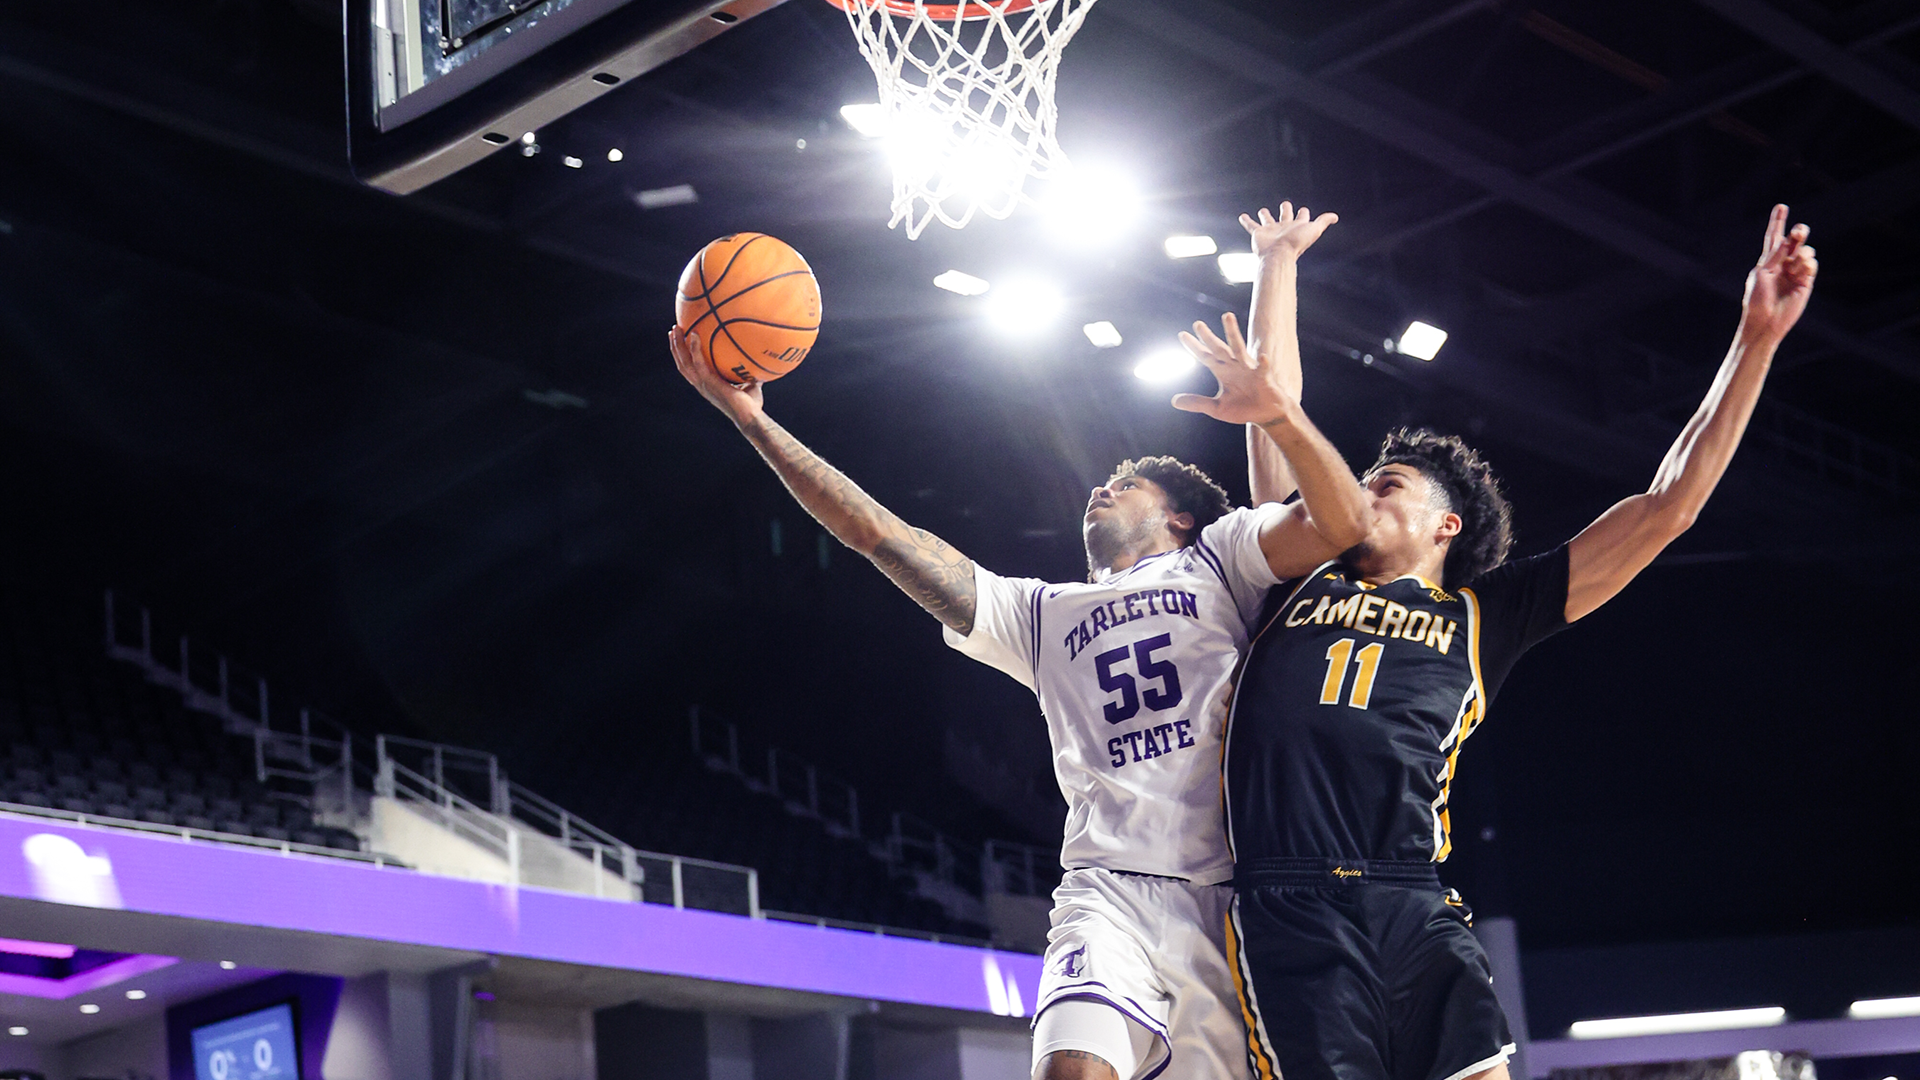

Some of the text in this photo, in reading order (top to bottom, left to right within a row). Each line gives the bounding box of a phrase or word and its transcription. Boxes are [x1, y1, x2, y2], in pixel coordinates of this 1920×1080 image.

[1064, 589, 1199, 662] TARLETON
[1285, 593, 1457, 655] CAMERON
[1094, 632, 1183, 725] 55
[1319, 637, 1385, 710] 11
[1108, 719, 1195, 769] STATE
[1330, 865, 1362, 880] Aggies
